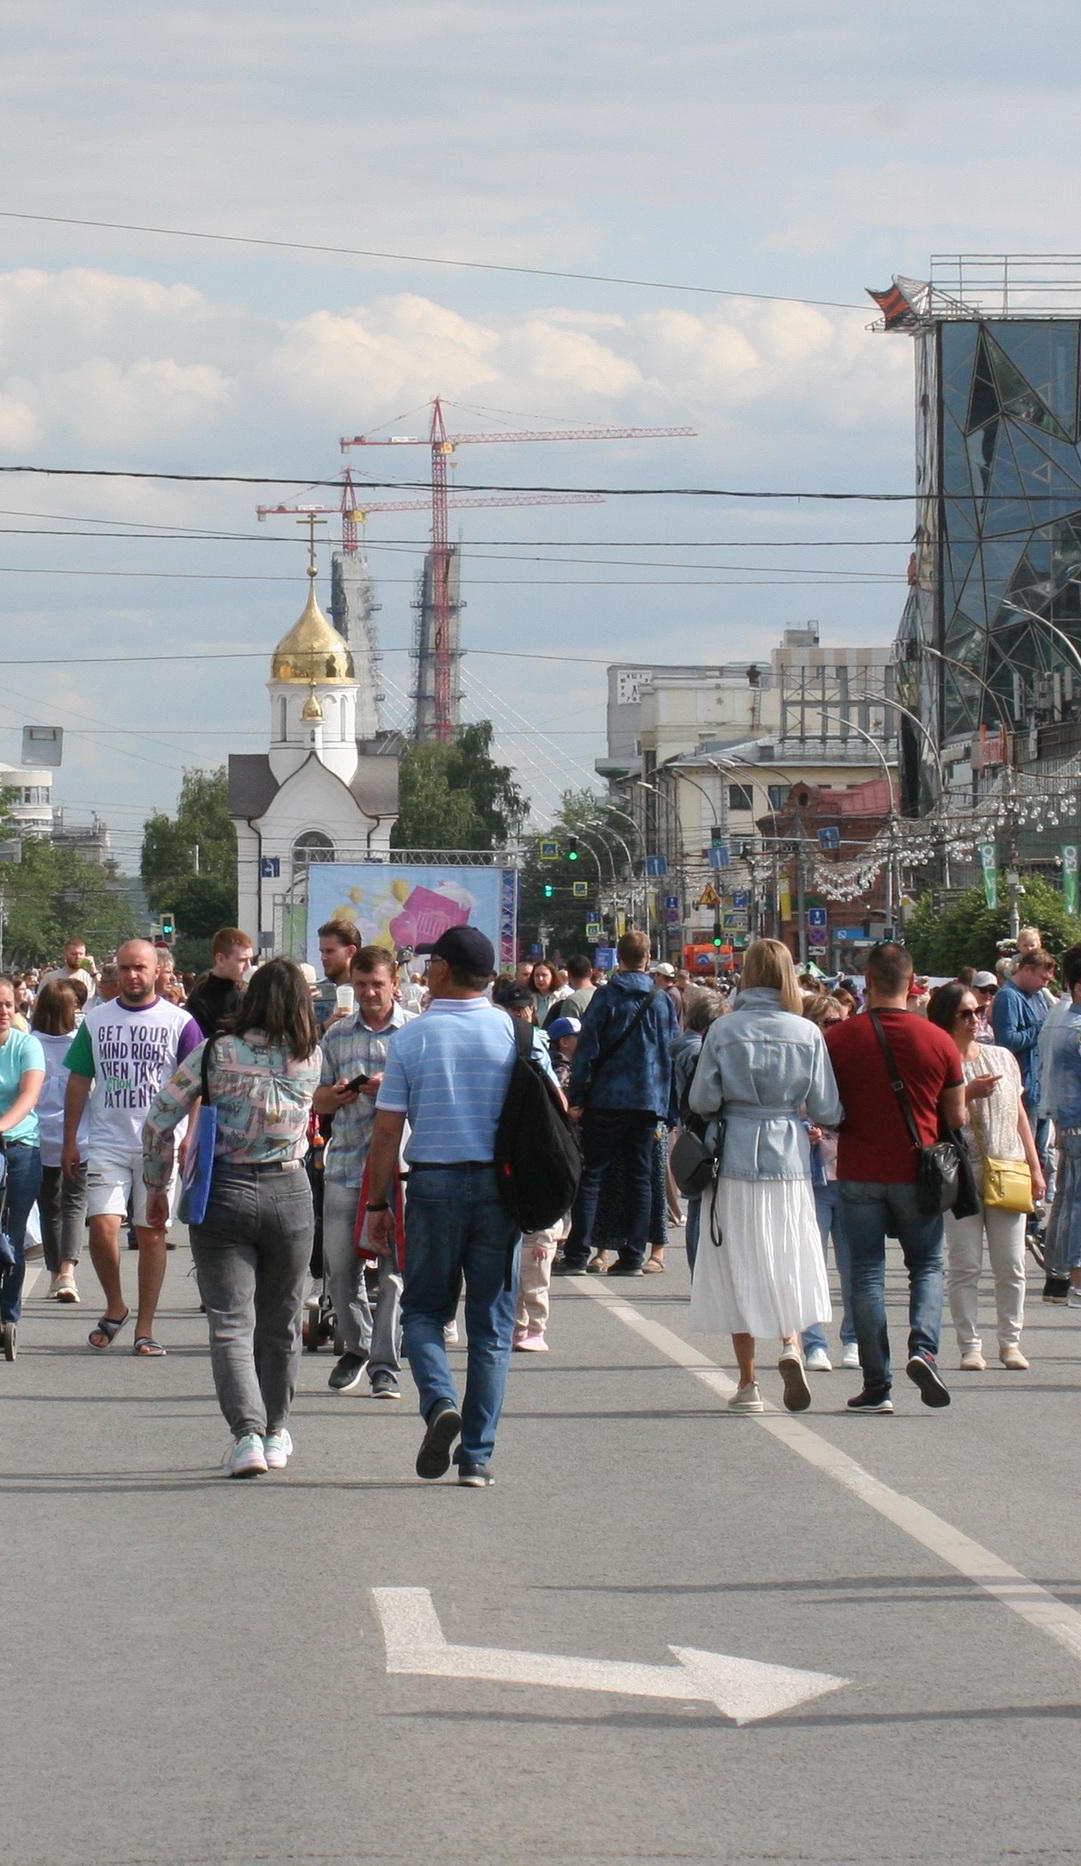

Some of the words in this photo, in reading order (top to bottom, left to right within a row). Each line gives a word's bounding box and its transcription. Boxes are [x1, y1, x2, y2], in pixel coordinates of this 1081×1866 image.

[981, 845, 996, 869] 130
[1064, 846, 1078, 872] 130
[98, 1025, 123, 1042] GET
[130, 1025, 169, 1043] YOUR
[99, 1042, 128, 1060] MIND
[131, 1043, 168, 1061] RIGHT
[100, 1061, 129, 1080] THEN
[133, 1061, 164, 1087] TAKE
